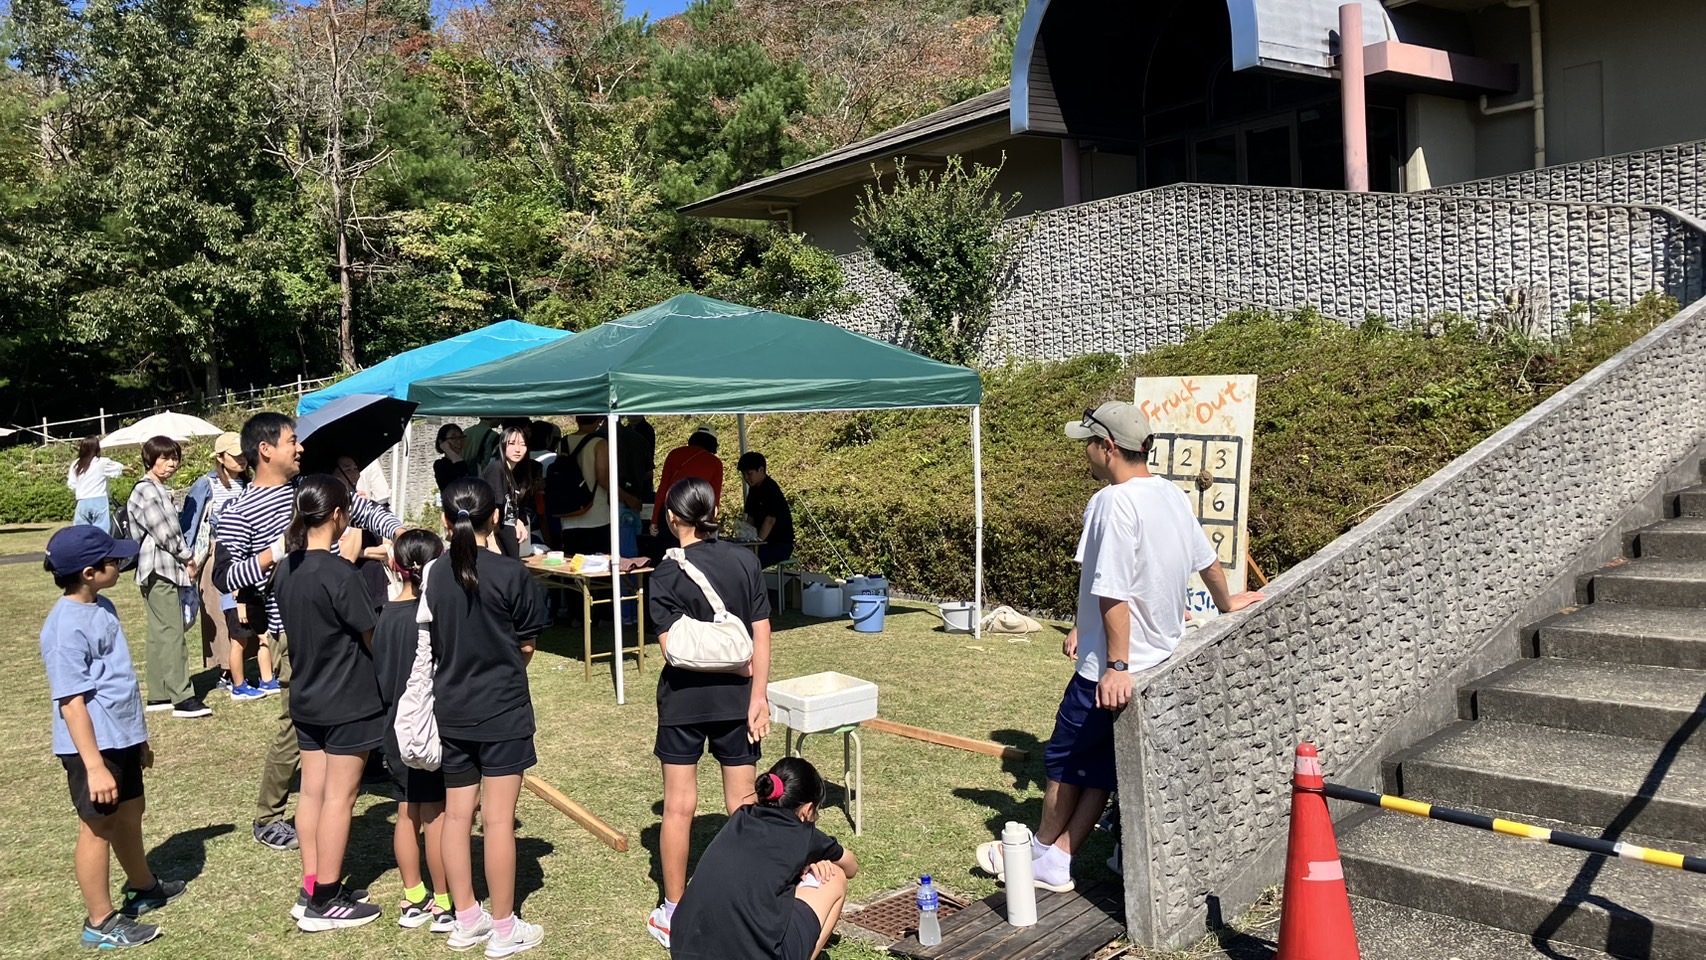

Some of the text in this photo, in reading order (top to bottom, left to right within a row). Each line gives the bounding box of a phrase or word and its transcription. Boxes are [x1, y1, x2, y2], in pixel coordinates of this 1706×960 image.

[1196, 381, 1242, 424] Out
[1148, 446, 1227, 470] 1 2 3
[1212, 491, 1225, 512] 6
[1211, 531, 1225, 555] 9
